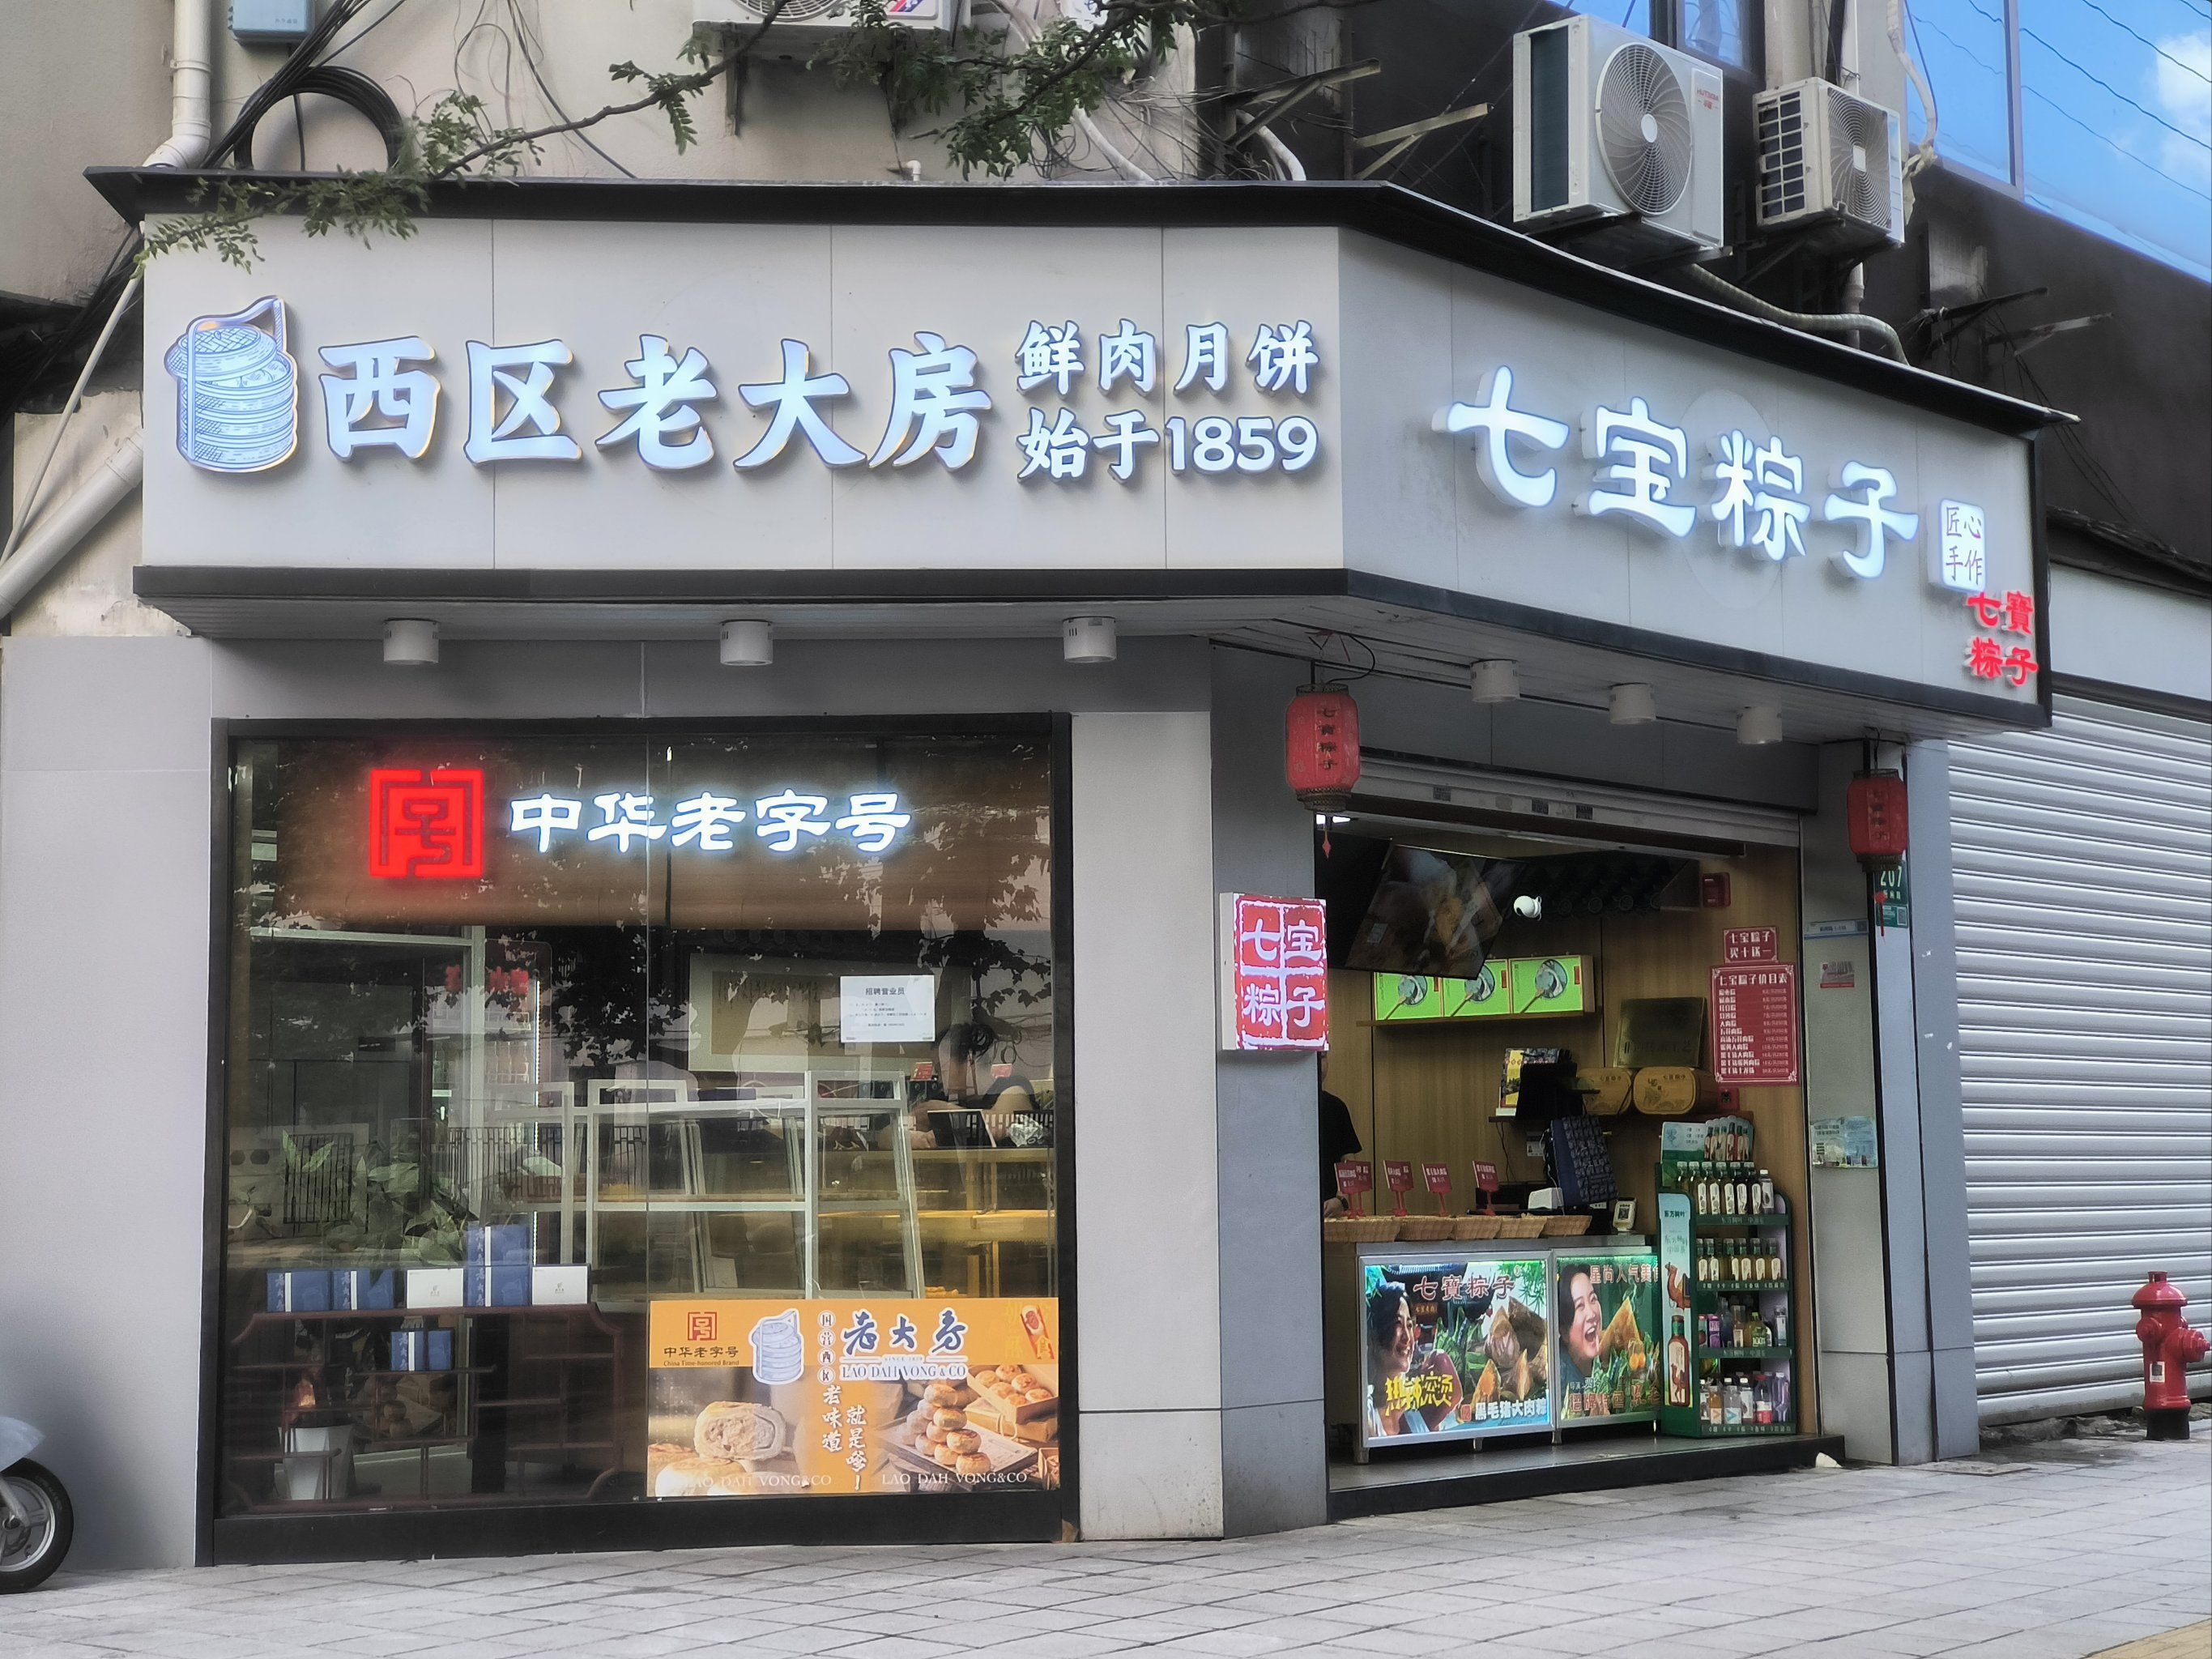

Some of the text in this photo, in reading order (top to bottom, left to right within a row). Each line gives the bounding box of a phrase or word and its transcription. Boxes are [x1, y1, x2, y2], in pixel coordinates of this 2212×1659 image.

[1016, 319, 1320, 397] 鲜肉月饼
[318, 331, 992, 472] 西区老大房
[1016, 407, 1320, 486] 始于1859
[1443, 364, 1920, 579] 七宝粽子
[1946, 506, 1982, 539] 匠心
[1946, 545, 1983, 586] 手作
[1966, 591, 2034, 634] 七寶
[1969, 636, 2039, 686] 粽子
[509, 788, 912, 854] 中华老字号
[1241, 918, 1323, 962] 七宝
[865, 987, 906, 996] 招聘营业员
[1242, 983, 1325, 1027] 粽子
[1413, 1274, 1515, 1301] 七寶粽子
[663, 1346, 739, 1358] 中华老字号
[843, 1309, 966, 1355] 老大房
[842, 1366, 867, 1378] LAO
[901, 1365, 936, 1377] VONG
[948, 1365, 966, 1377] CO
[822, 1384, 842, 1452] 老味道
[881, 1471, 1028, 1484] LAO DAH VONG&CO
